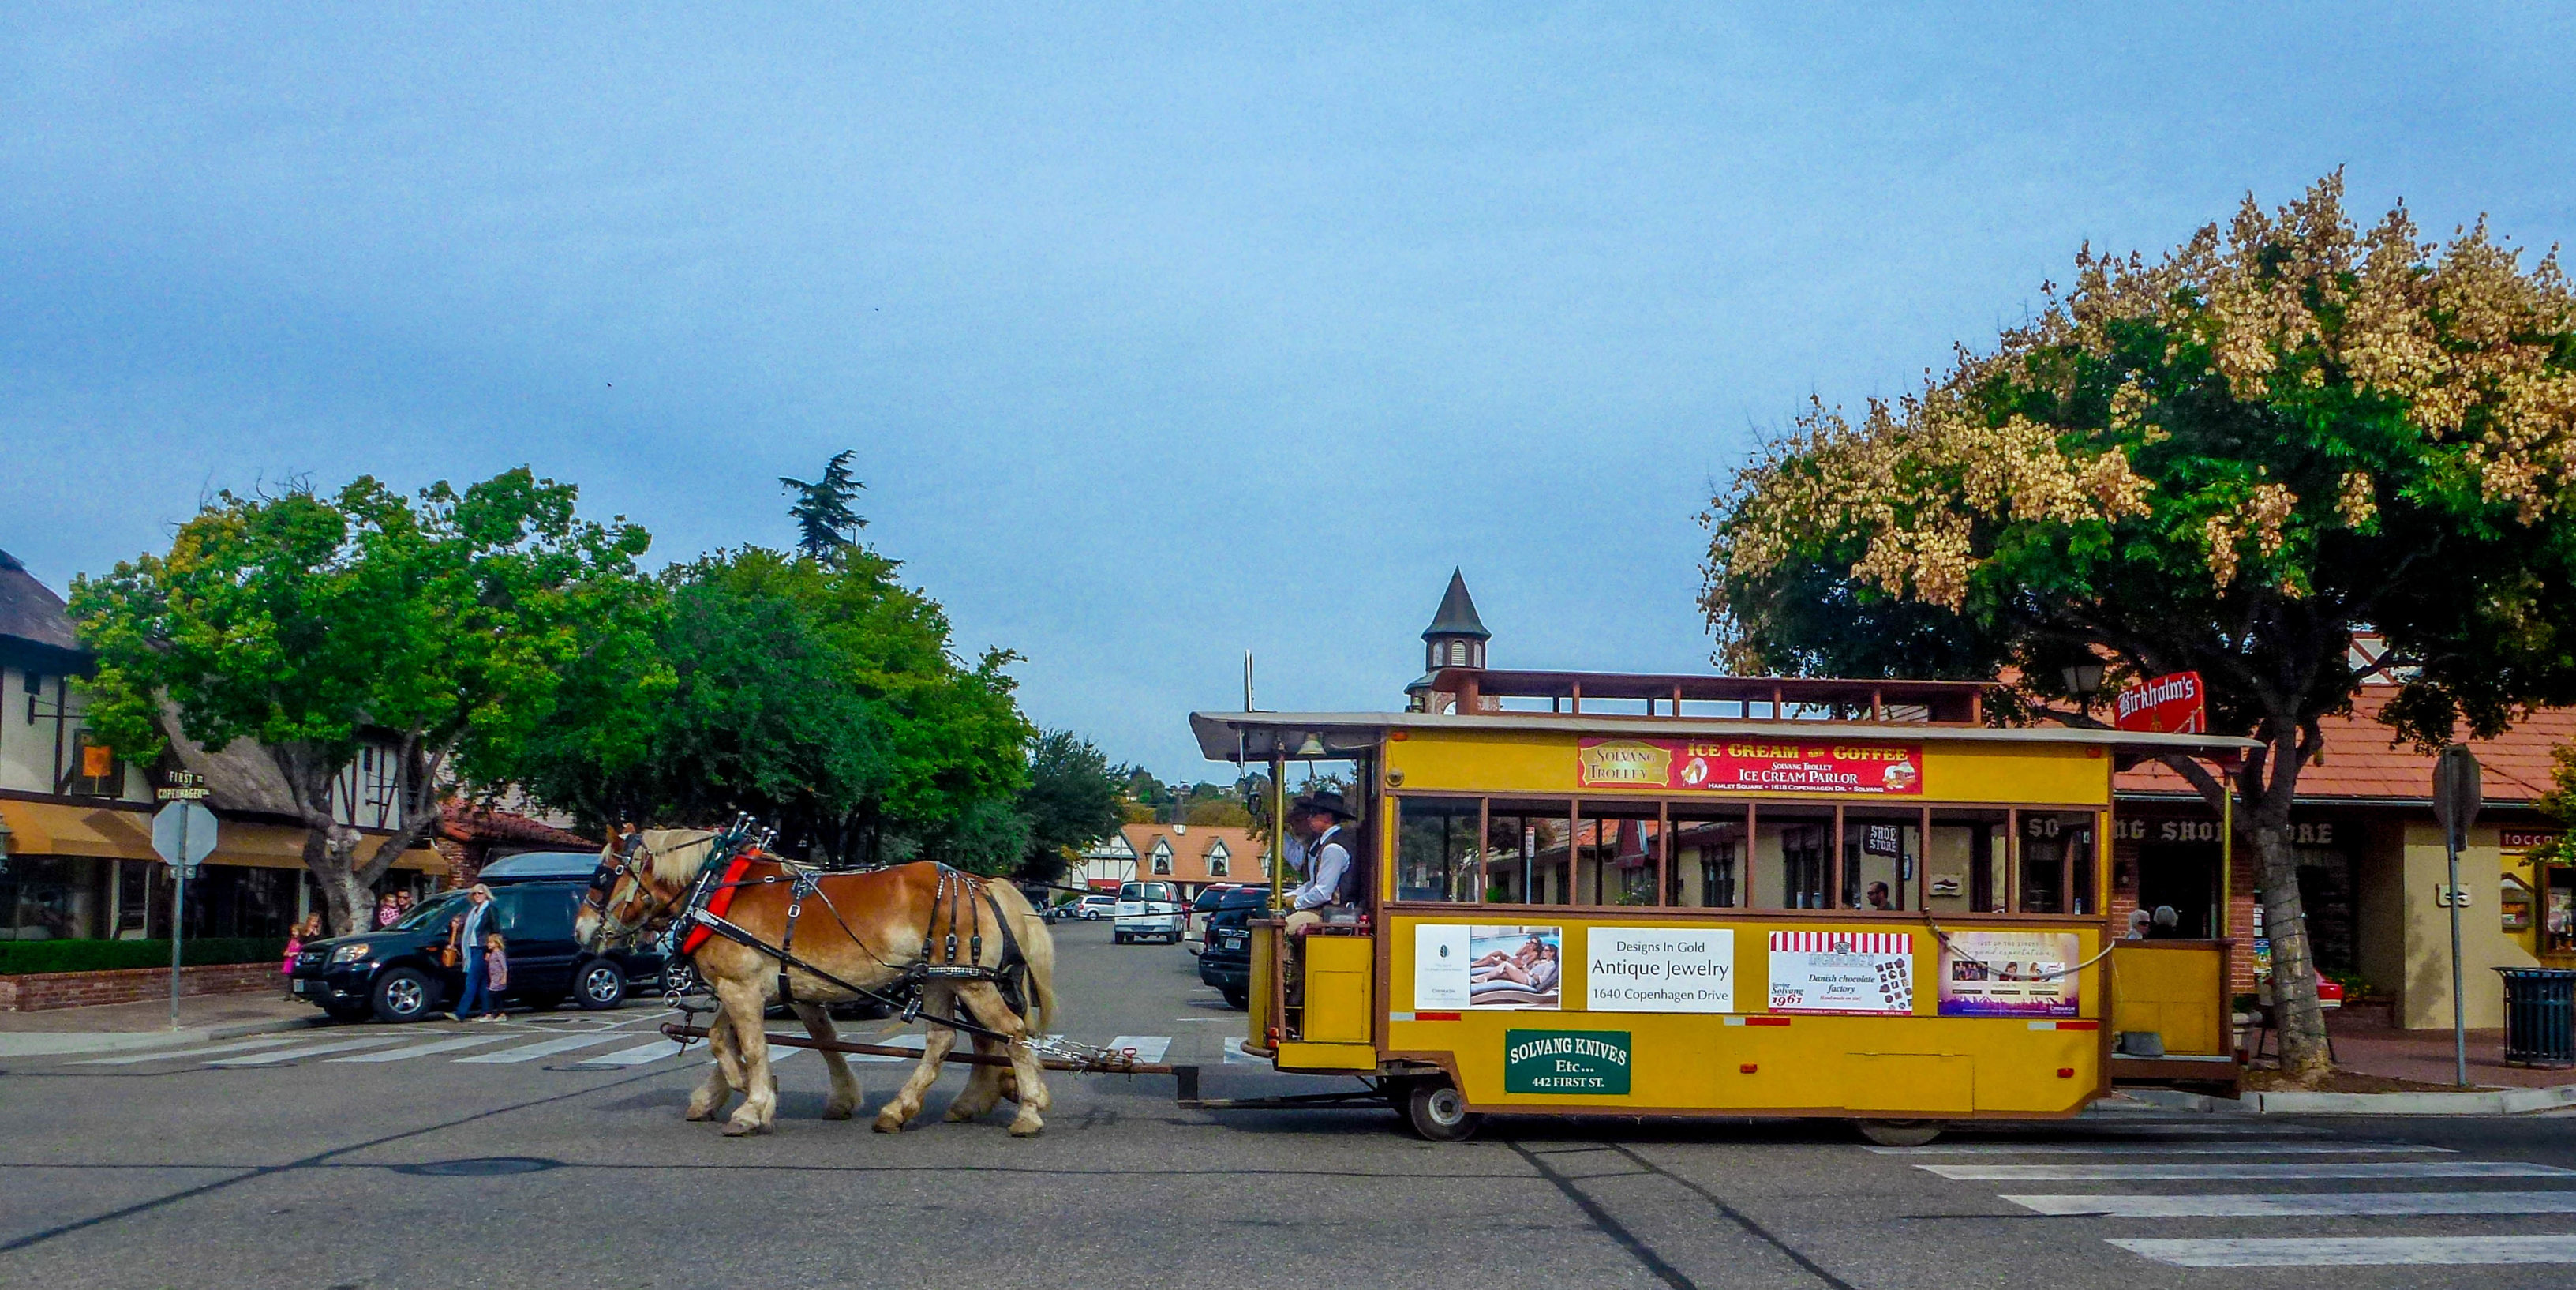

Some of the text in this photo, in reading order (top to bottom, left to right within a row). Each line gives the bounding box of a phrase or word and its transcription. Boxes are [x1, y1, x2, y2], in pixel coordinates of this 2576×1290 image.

[2118, 676, 2194, 722] Birkholm's
[1597, 748, 1657, 762] SOLVANG
[1688, 743, 1720, 756] ICE
[1728, 744, 1799, 759] CREAM
[1833, 746, 1908, 761] COFFEE
[1589, 764, 1648, 779] TROLLEY
[1771, 762, 1832, 771] SOLVANG TROLLEY
[169, 771, 193, 785] FIRST
[1739, 769, 1857, 784] ICE CREAM PARLOR
[1870, 825, 1896, 842] SHOE
[1870, 839, 1896, 853] STORE
[1617, 941, 1705, 954] Designs In Gold
[1592, 959, 1728, 981] Antique Jewelry
[1593, 988, 1728, 1003] 1640 Copenhagen Drive
[1772, 986, 1803, 996] Solvang
[1827, 984, 1855, 994] factory
[1773, 994, 1802, 1006] 1961
[1511, 1038, 1627, 1066] SOLVANG KNIVES
[1556, 1059, 1594, 1072] Etc...
[1532, 1078, 1604, 1087] 442 FIRST ST.
